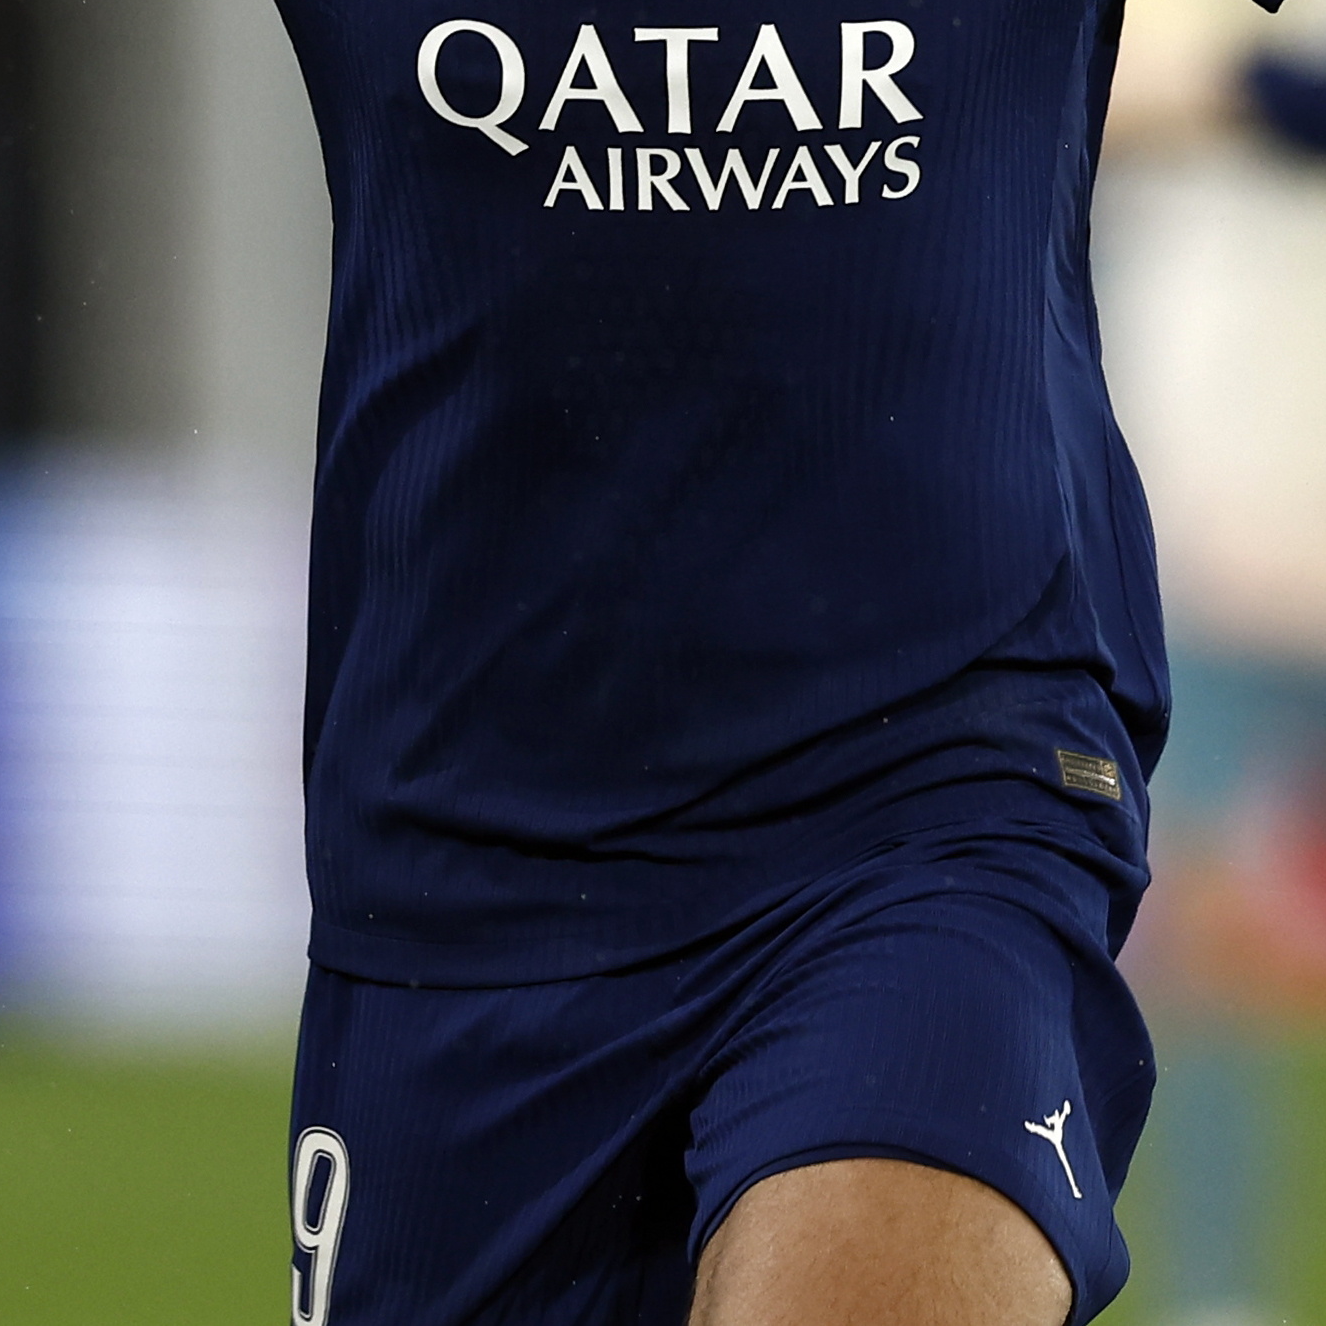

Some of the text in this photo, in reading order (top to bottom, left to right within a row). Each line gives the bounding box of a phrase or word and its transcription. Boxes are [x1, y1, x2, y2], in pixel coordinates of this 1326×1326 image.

[417, 19, 924, 156] QATAR
[543, 136, 921, 211] AIRWAYS
[291, 1126, 351, 1326] 9
